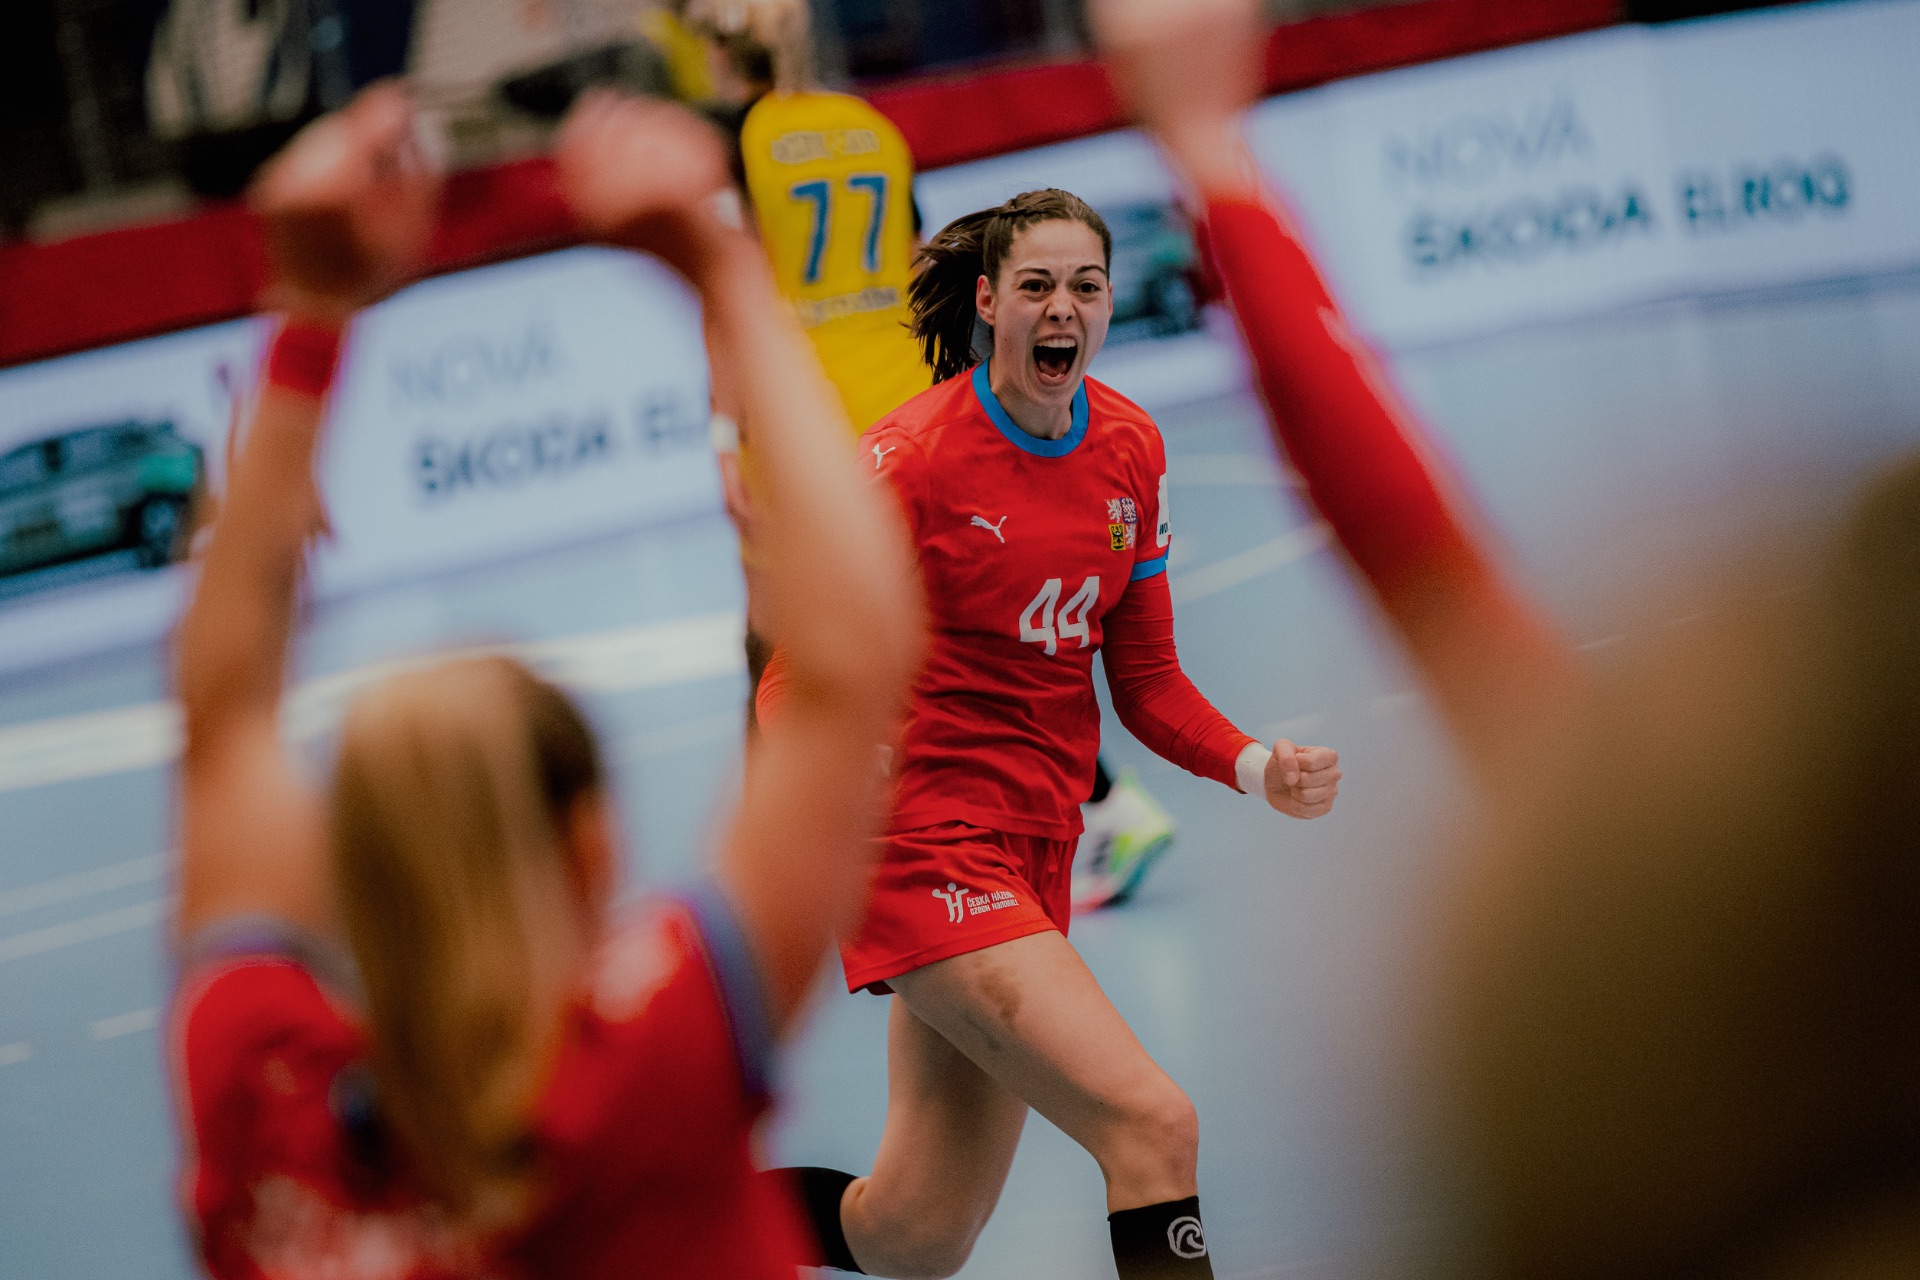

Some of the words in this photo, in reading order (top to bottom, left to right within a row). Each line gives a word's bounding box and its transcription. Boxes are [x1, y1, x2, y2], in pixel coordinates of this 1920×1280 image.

[789, 171, 888, 285] 77
[1018, 575, 1100, 656] 44
[966, 892, 991, 908] ČESKÁ
